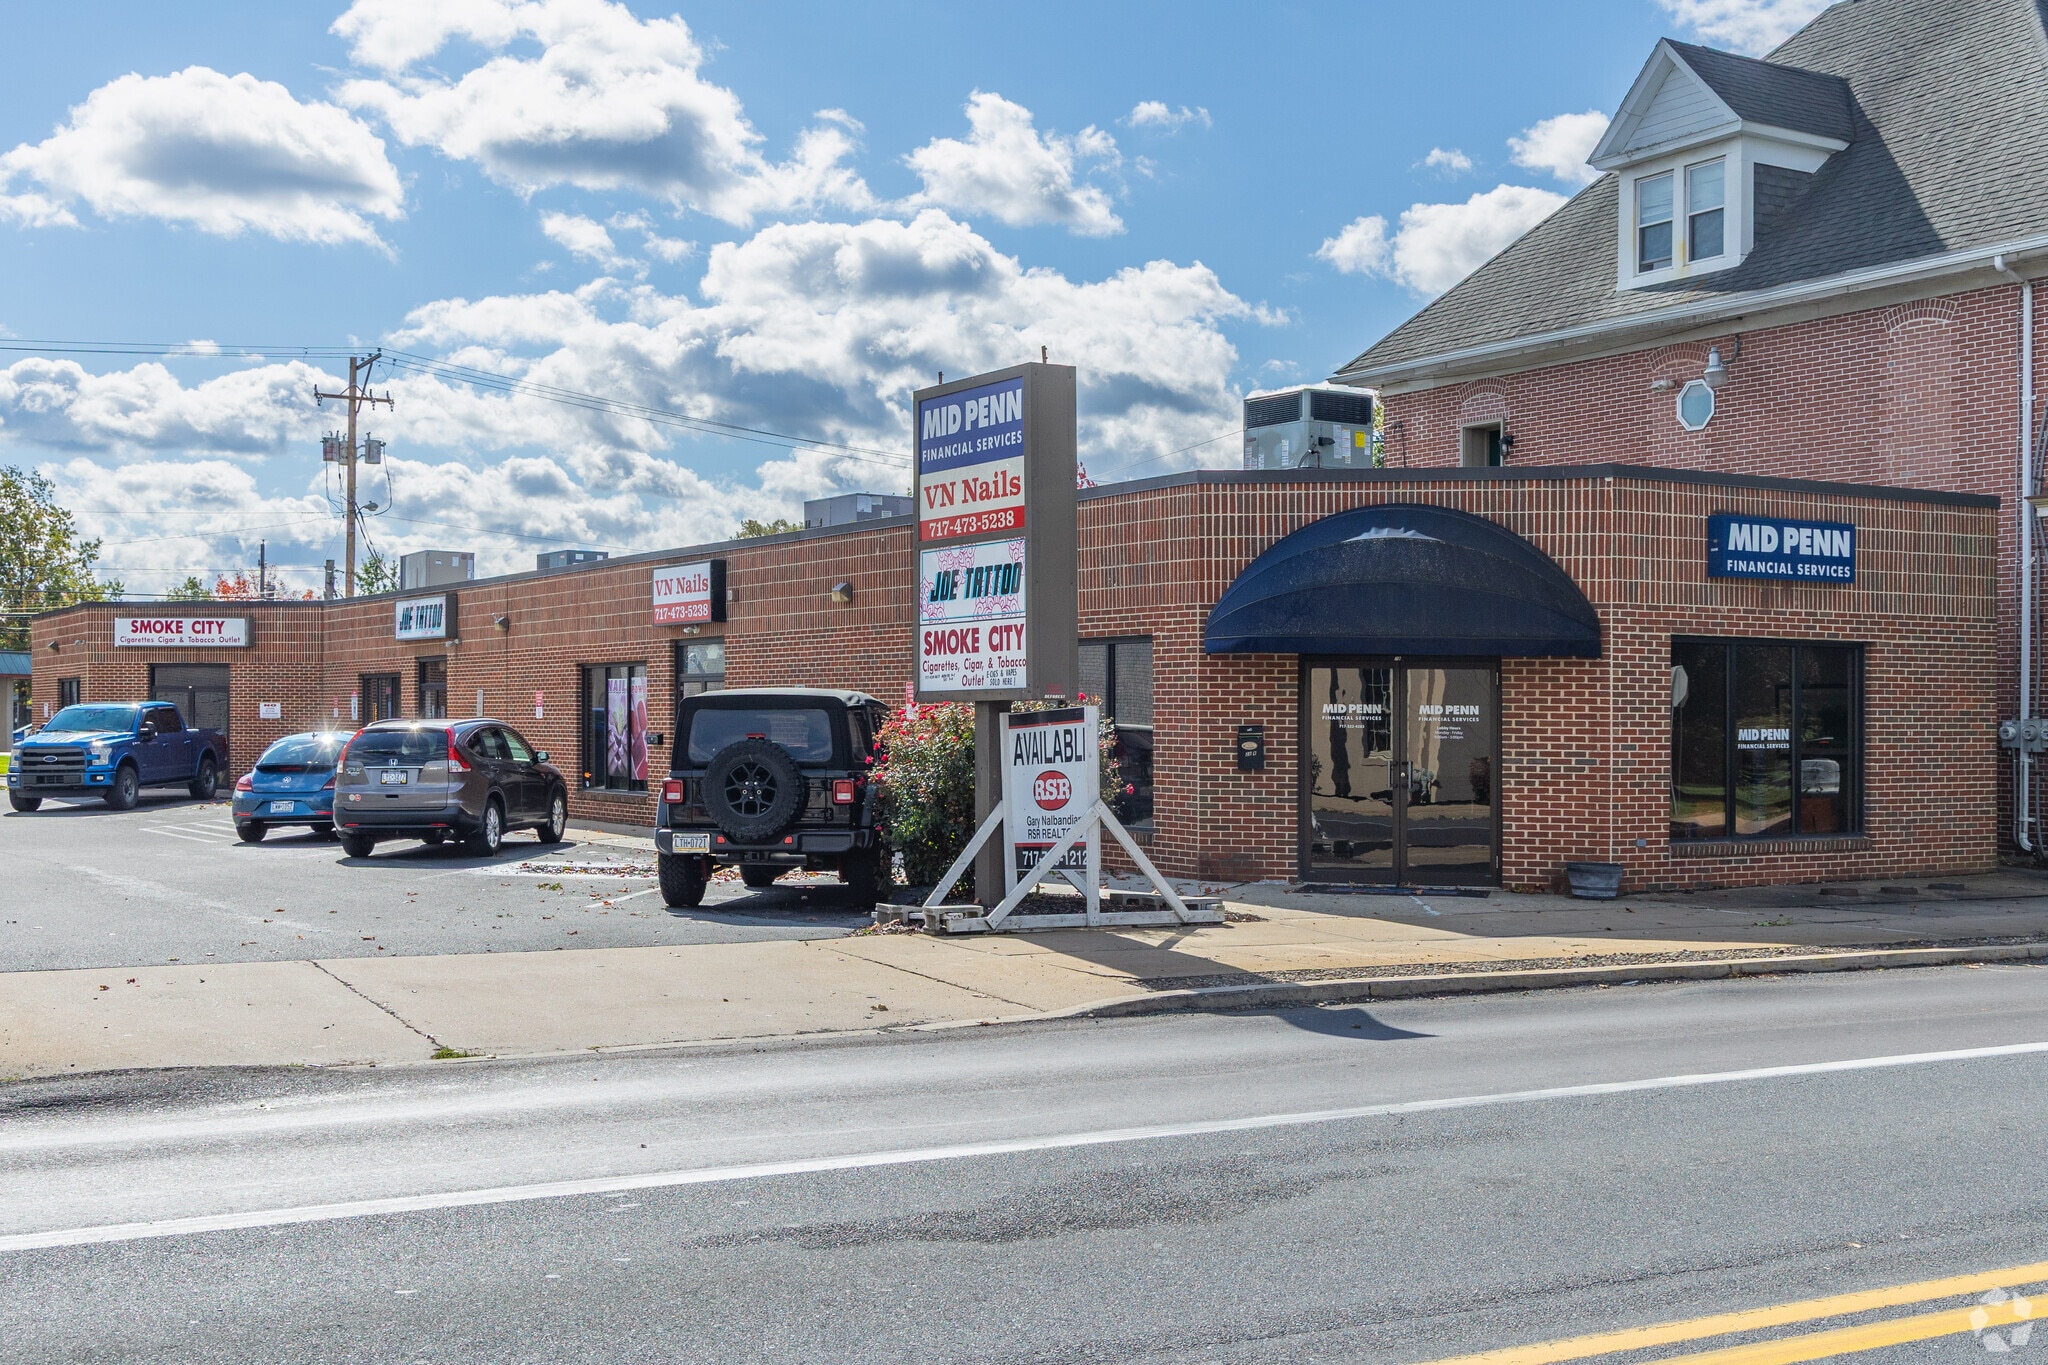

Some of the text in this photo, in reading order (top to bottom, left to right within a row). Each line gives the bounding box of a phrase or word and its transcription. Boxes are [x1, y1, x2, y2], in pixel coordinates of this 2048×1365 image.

[923, 389, 1022, 440] MID PENN
[922, 431, 1022, 462] FINANCIAL SERVICES
[924, 470, 1021, 510] VN Nails
[929, 510, 1015, 537] 717-473-5238
[1728, 523, 1779, 553] MID
[1783, 526, 1850, 558] PENN
[1727, 560, 1850, 578] FINANCIAL SERVICES
[655, 573, 709, 597] VN Nails
[929, 562, 1022, 602] JOE TATTOO
[399, 603, 443, 630] JOE TATTOO
[654, 603, 708, 620] 717-473-5238
[130, 619, 226, 634] SMOKE CITY
[119, 636, 154, 644] Cigarettes
[157, 636, 176, 644] Cigar
[923, 623, 1025, 656] SMOKE CITY
[922, 660, 960, 674] Cigarettes,
[988, 658, 993, 669] &
[997, 656, 1027, 669] Tobacco
[961, 674, 985, 687] Outlet
[1322, 703, 1382, 714] MID PENN
[1419, 705, 1479, 715] MID PENN
[1738, 728, 1790, 741] MID PENN
[1034, 778, 1070, 801] RSR
[1026, 815, 1041, 828] Gary
[1028, 829, 1041, 840] RSR
